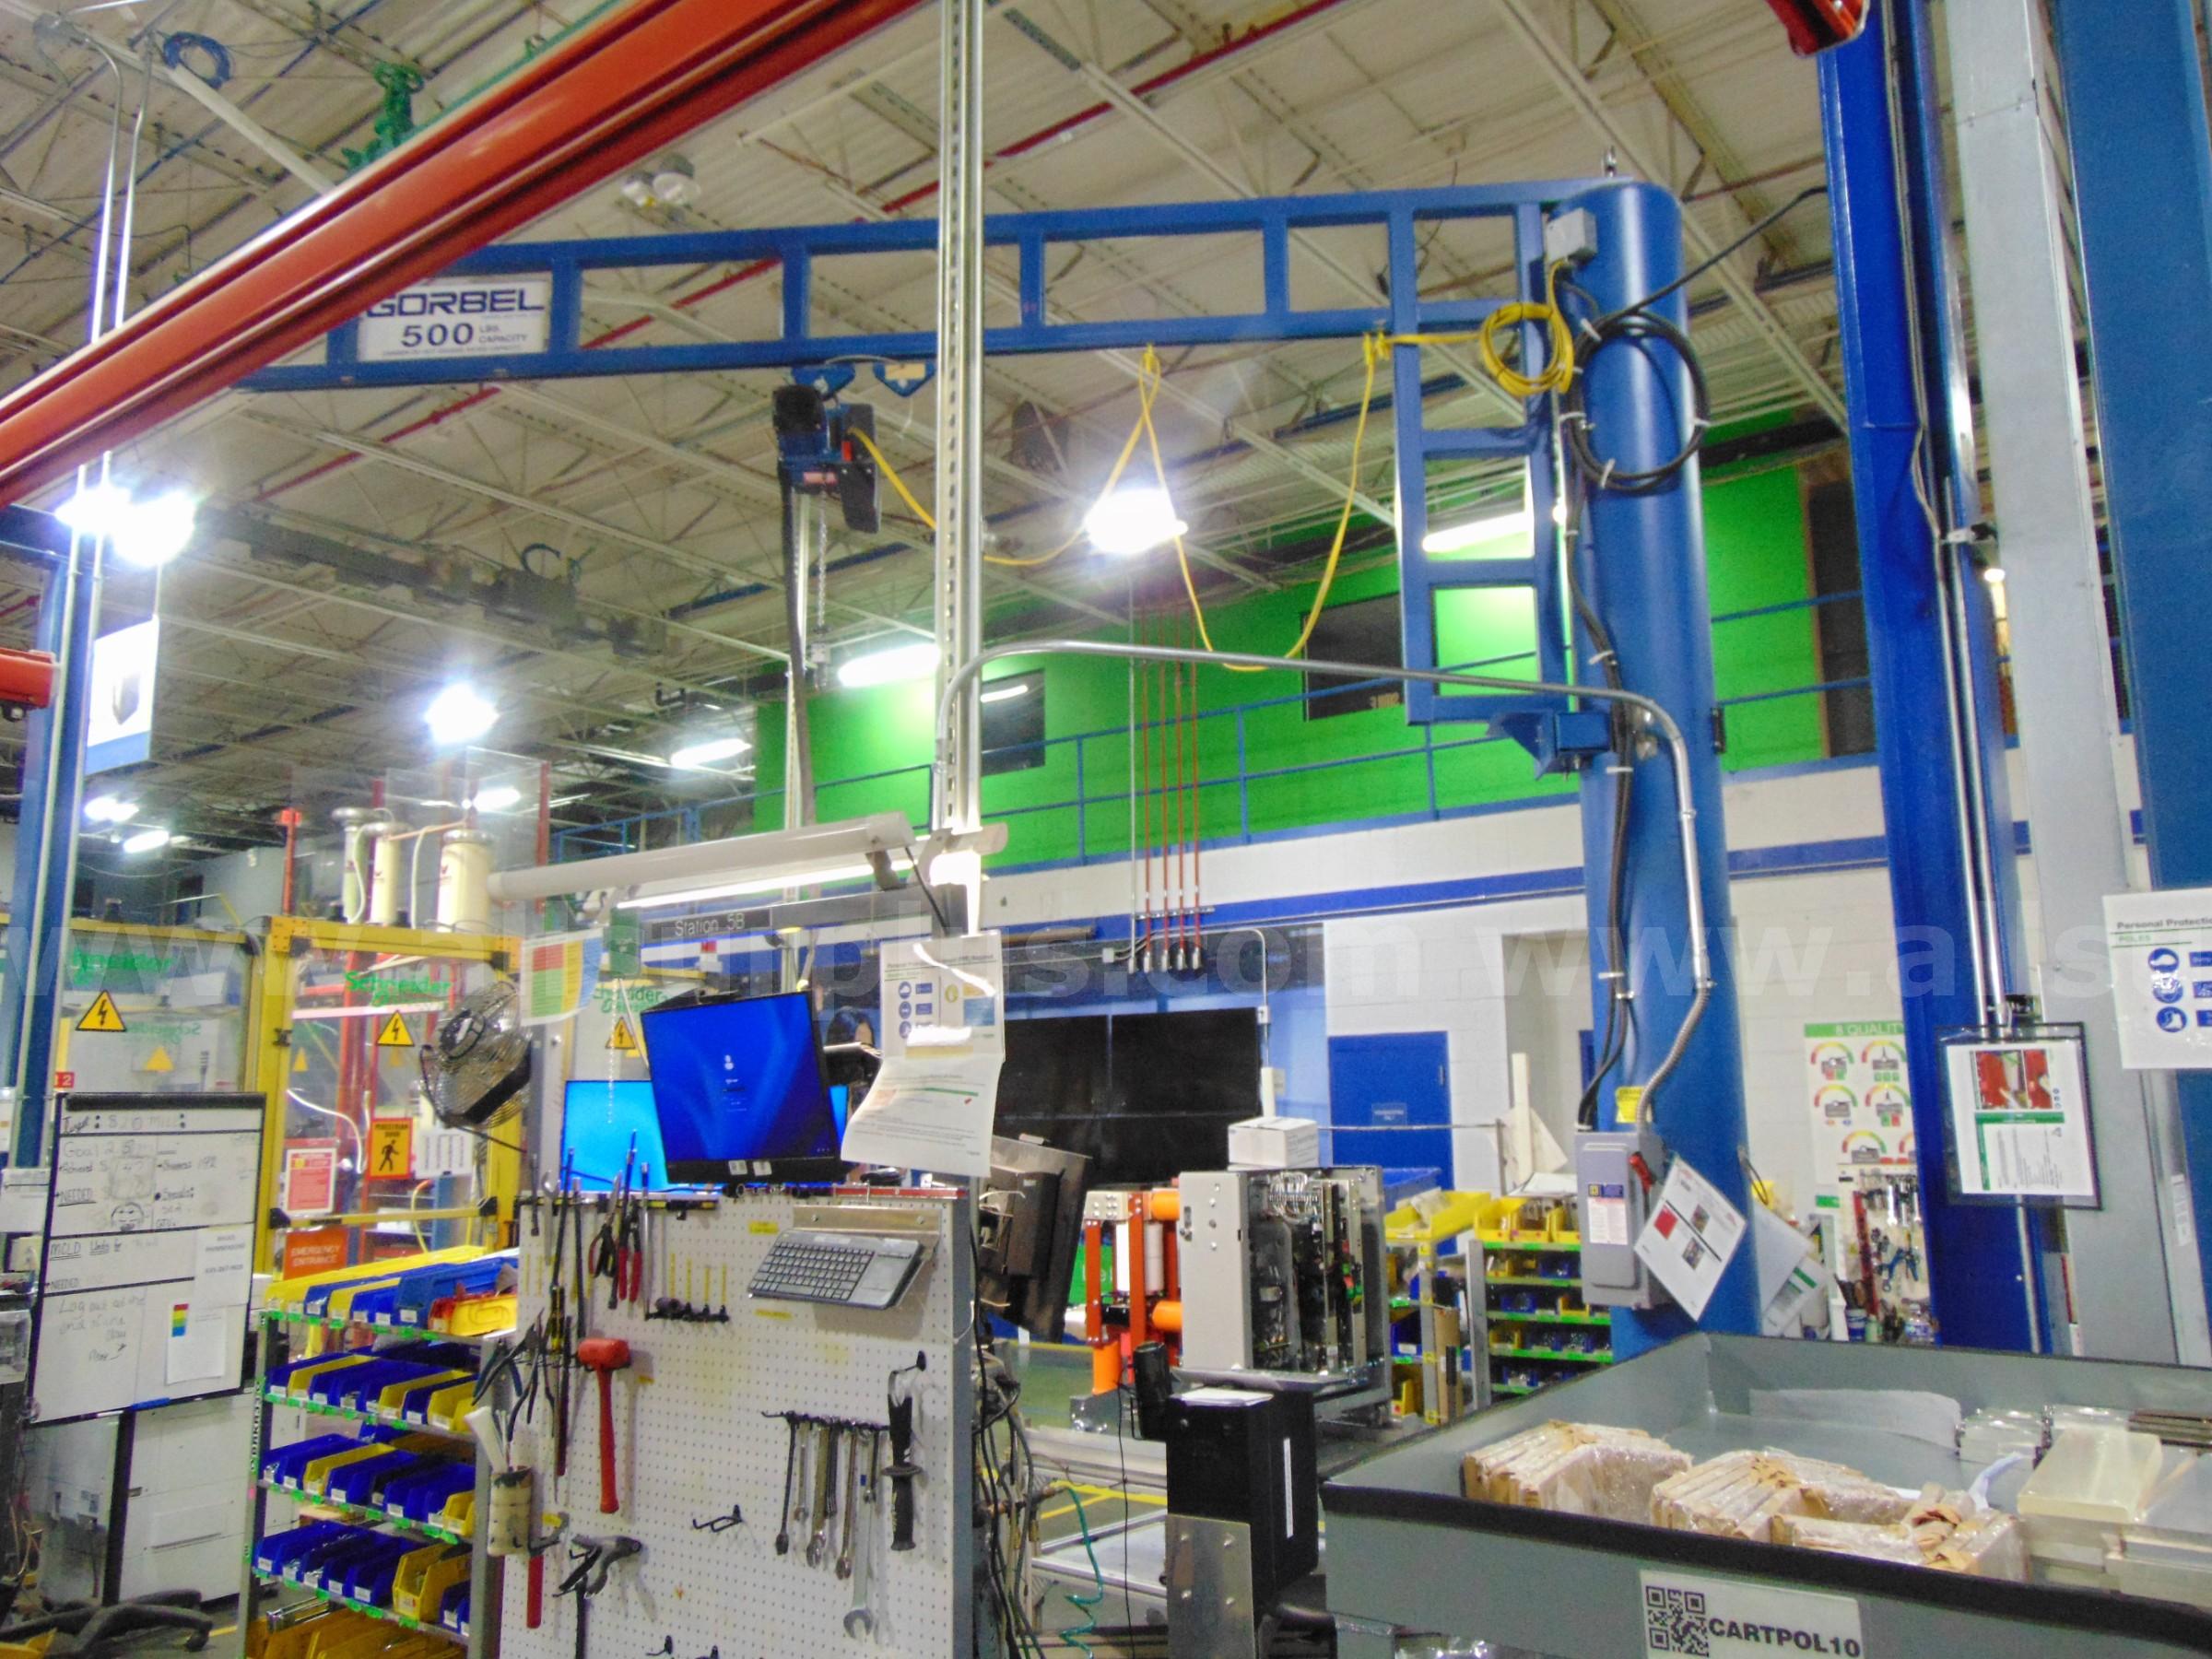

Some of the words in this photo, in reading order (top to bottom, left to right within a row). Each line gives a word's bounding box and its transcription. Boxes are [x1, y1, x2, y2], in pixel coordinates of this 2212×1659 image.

[366, 288, 545, 318] GORBEL
[401, 323, 475, 347] 500
[675, 919, 718, 937] Station
[727, 912, 745, 930] 5B
[2116, 919, 2164, 930] Personal
[1708, 1618, 1861, 1658] CARTPOL10
